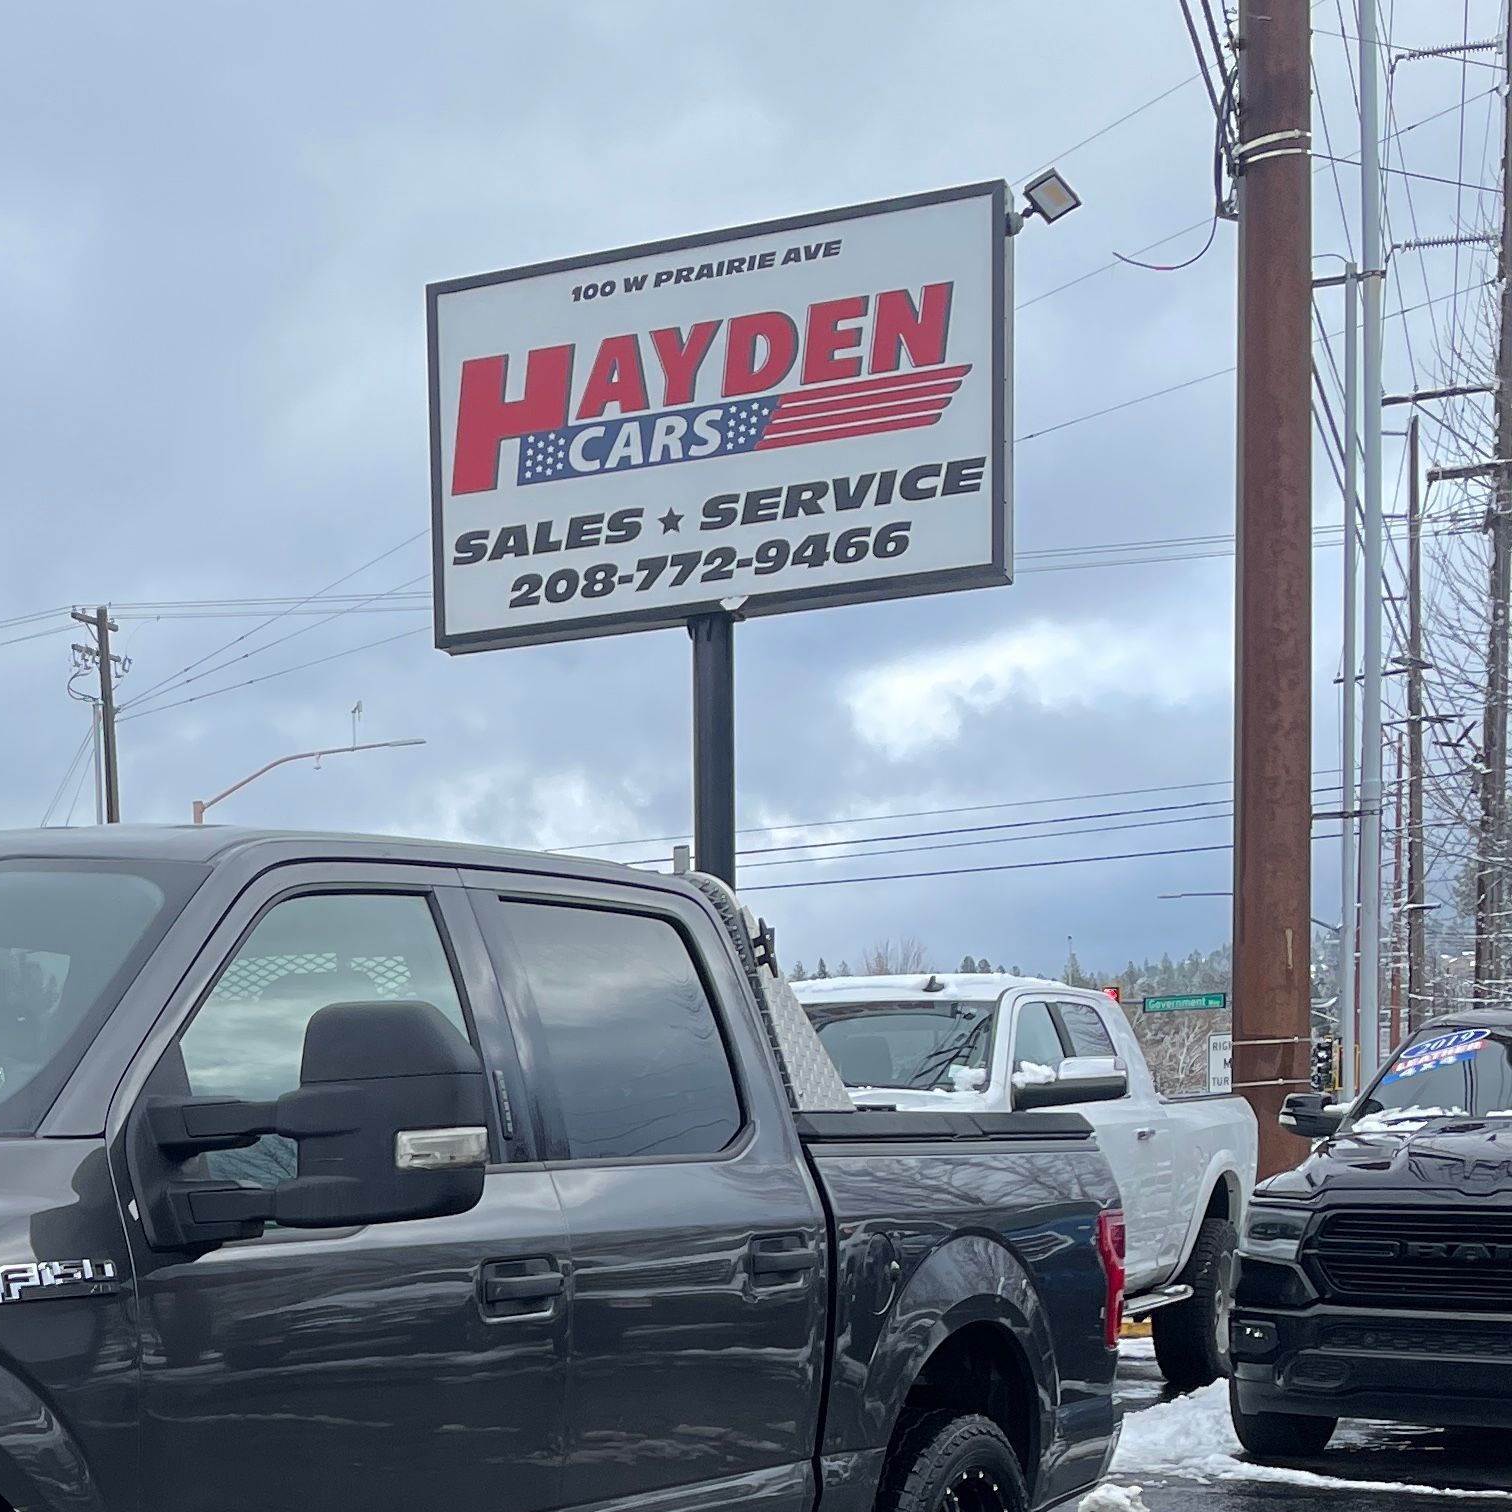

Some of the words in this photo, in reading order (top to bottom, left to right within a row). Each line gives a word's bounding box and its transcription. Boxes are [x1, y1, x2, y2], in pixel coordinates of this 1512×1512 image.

[571, 280, 615, 302] 100
[623, 274, 650, 292] W
[653, 251, 777, 288] PRAIRIE
[781, 239, 842, 266] AVE
[451, 281, 954, 496] HAYDEN
[567, 408, 724, 473] CARS
[452, 507, 644, 565] SALES
[699, 456, 987, 531] SERVICE
[509, 521, 912, 608] 208-772-9466
[1148, 998, 1206, 1010] Government
[1212, 1040, 1231, 1051] RIG
[1212, 1076, 1230, 1087] TUR
